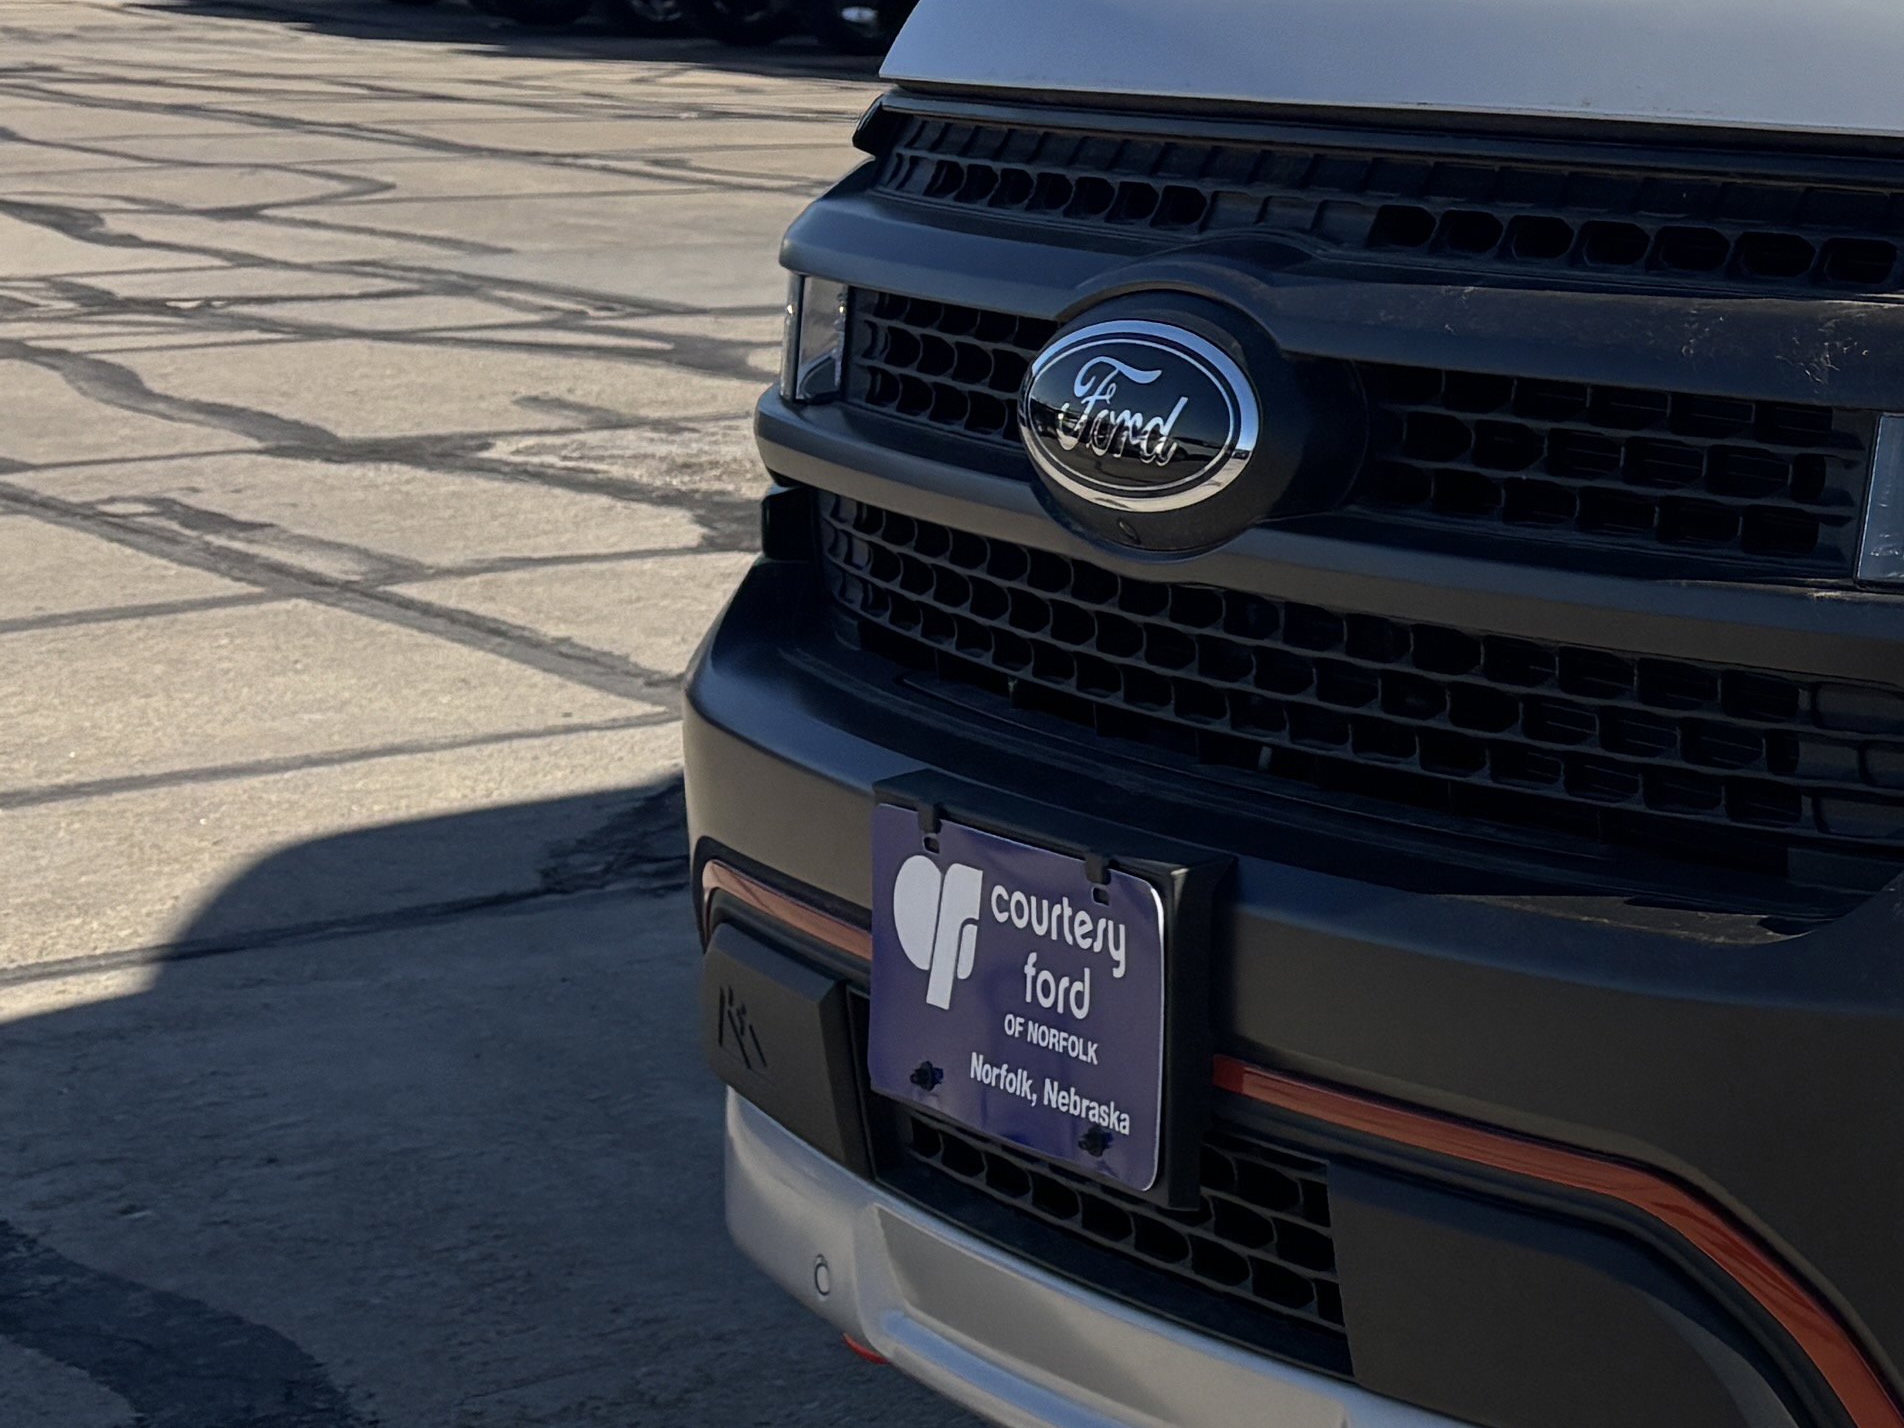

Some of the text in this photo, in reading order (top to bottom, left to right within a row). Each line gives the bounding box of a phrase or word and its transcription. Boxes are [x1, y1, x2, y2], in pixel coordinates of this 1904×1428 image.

[1057, 356, 1189, 467] Ford
[990, 884, 1126, 979] courtesy
[1024, 952, 1091, 1020] ford
[1004, 1013, 1099, 1066] OF NORFOLK
[970, 1051, 1131, 1136] Norfolk, Nebraska
